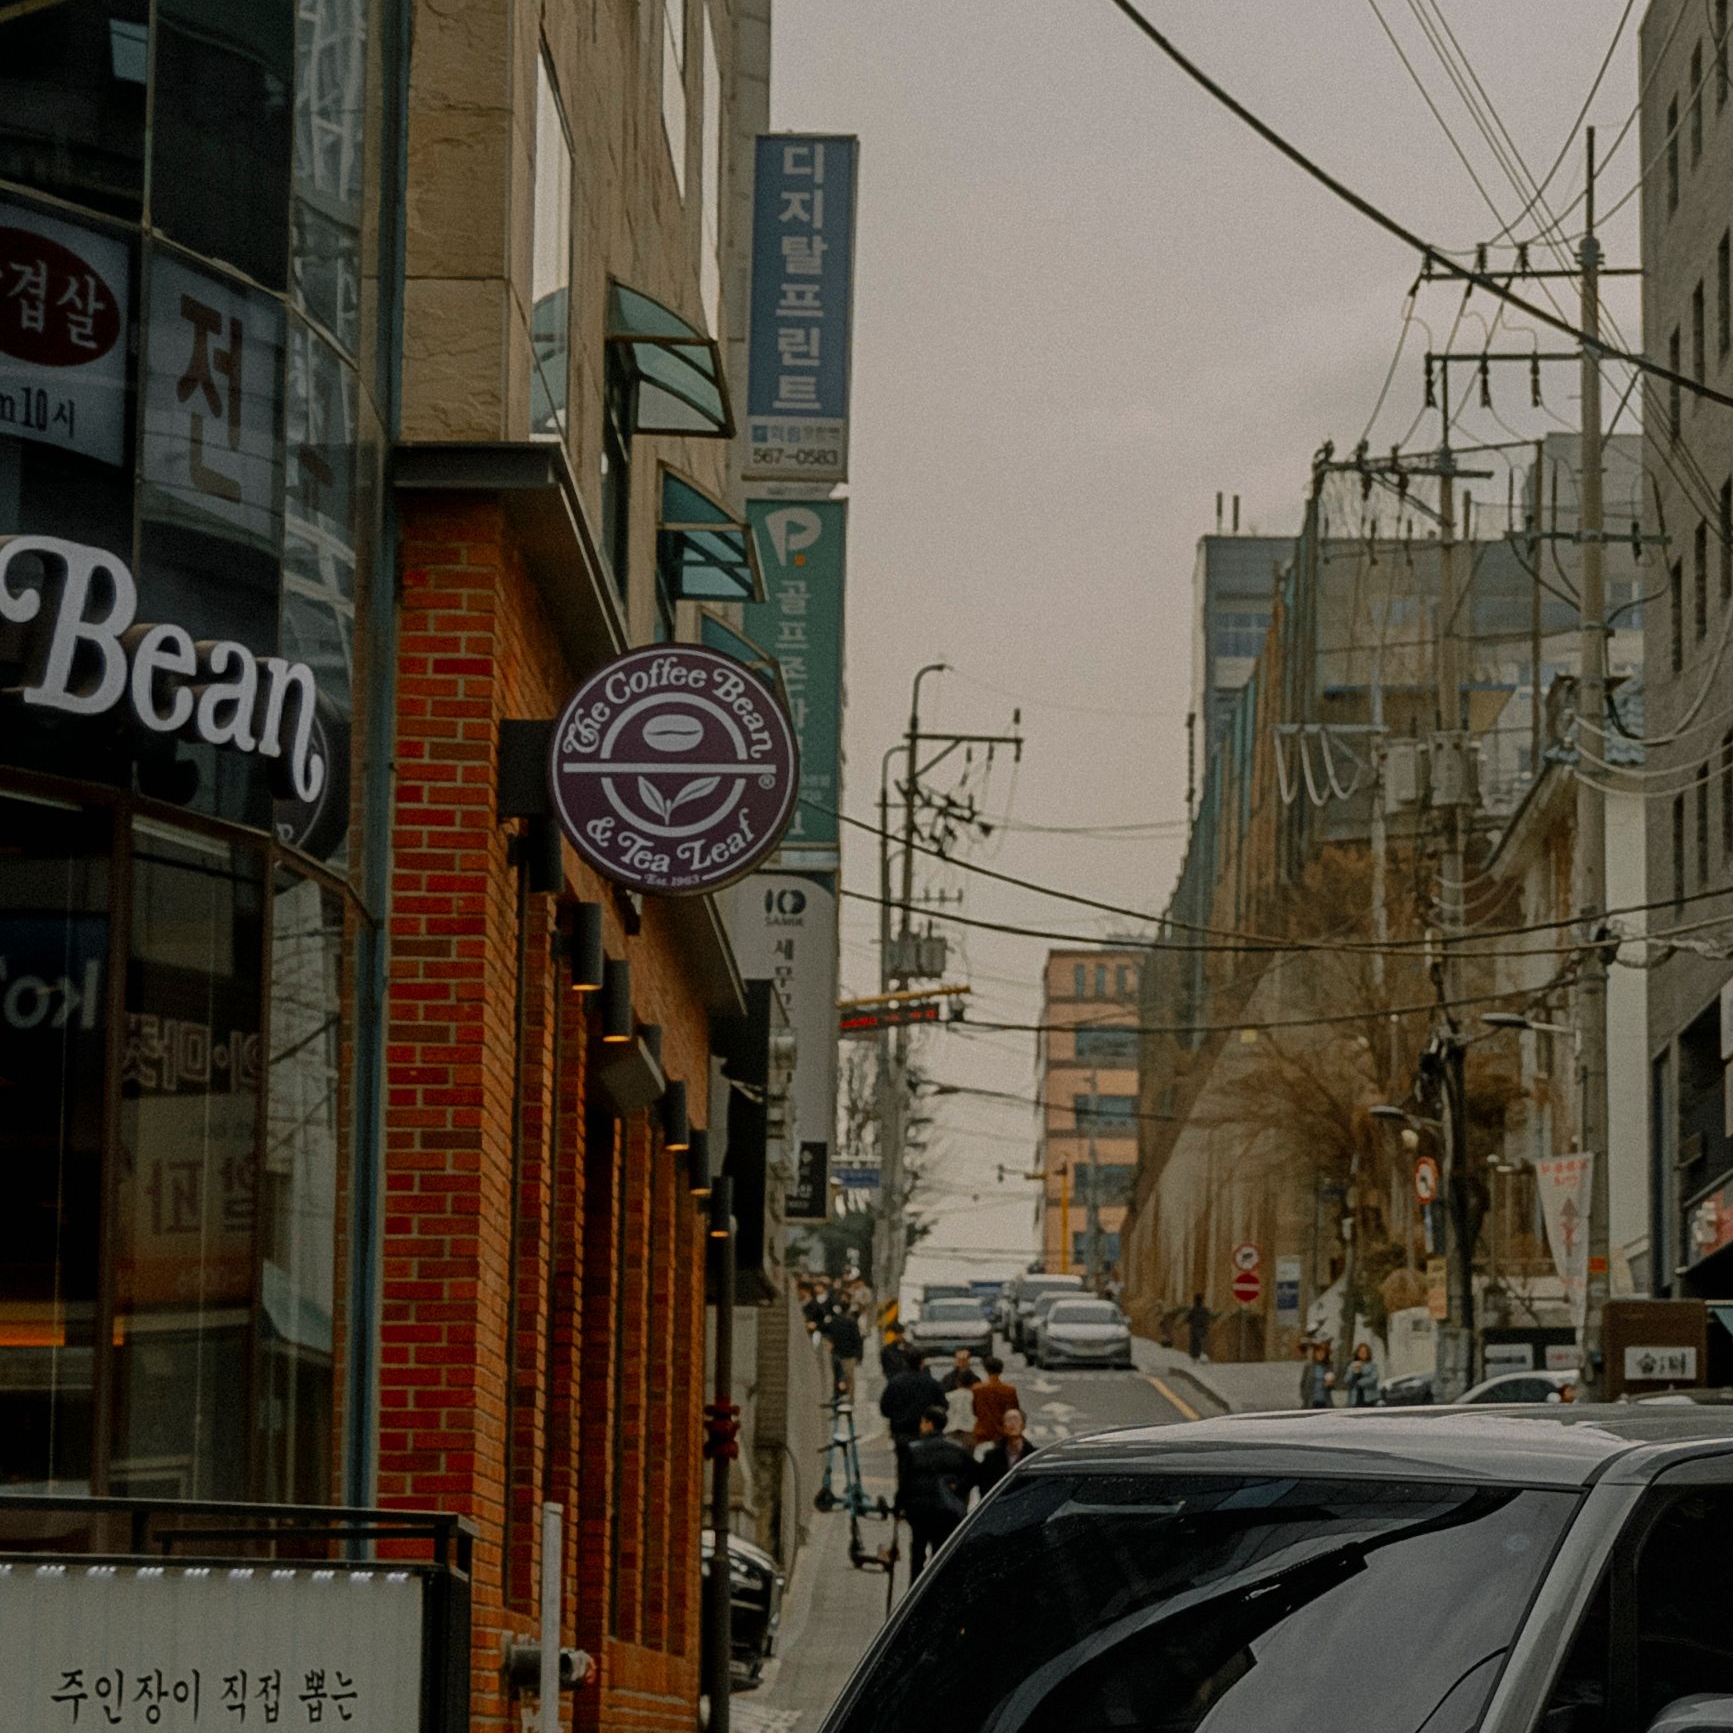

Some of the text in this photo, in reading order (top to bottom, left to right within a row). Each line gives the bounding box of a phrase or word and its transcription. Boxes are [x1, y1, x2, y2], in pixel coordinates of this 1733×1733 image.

[0, 260, 106, 350] 겹살
[176, 293, 242, 503] 전
[0, 534, 324, 803] Bean
[562, 656, 773, 759] The Coffee Bean
[617, 830, 671, 873] Tea
[676, 807, 756, 871] Leaf
[51, 1668, 358, 1725] 주인장이 직접 뽑는
